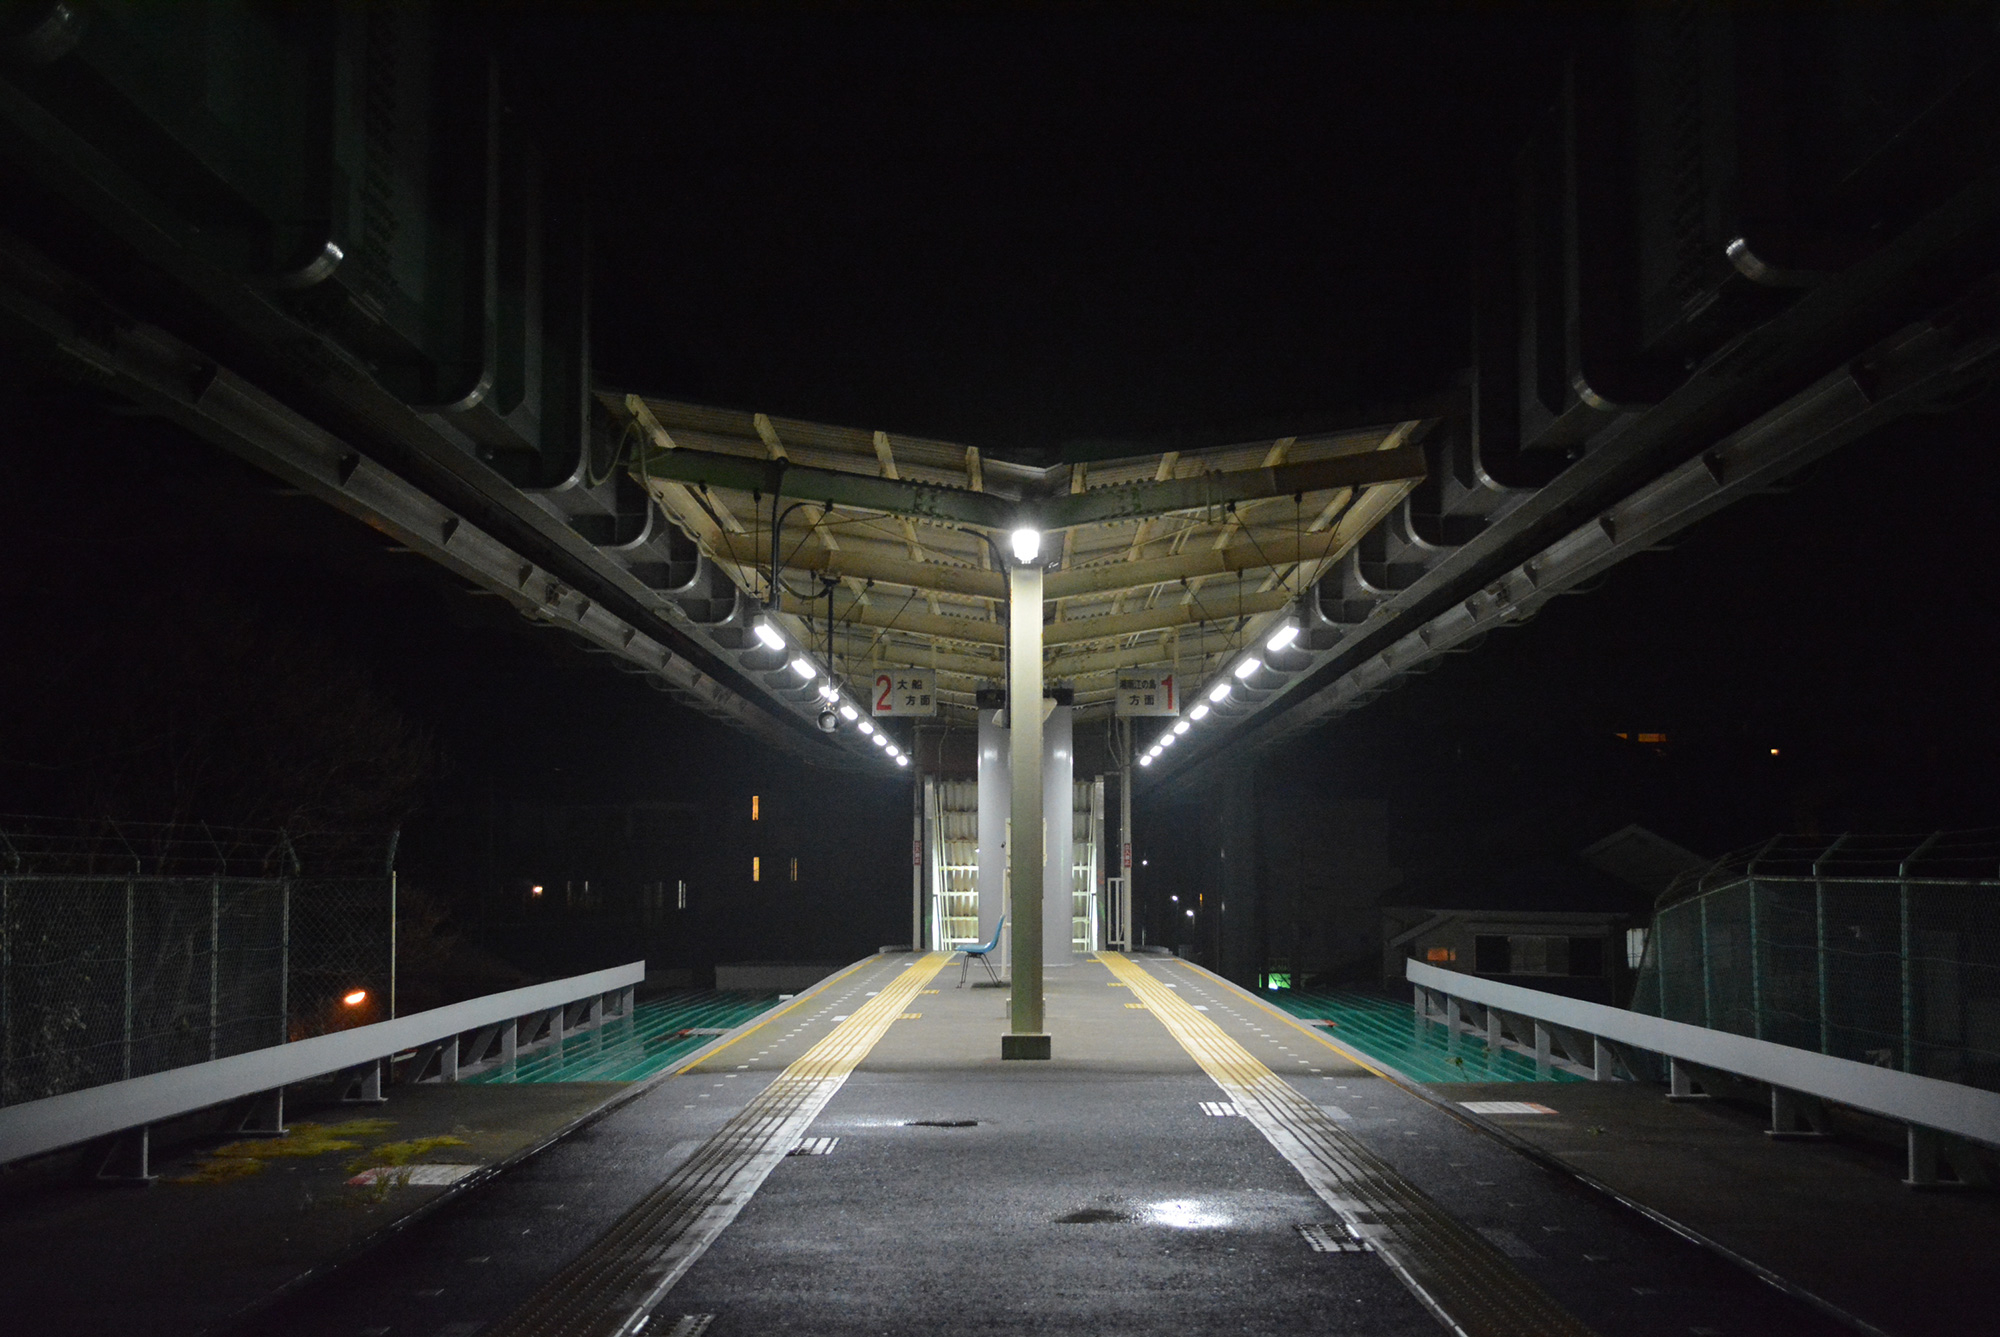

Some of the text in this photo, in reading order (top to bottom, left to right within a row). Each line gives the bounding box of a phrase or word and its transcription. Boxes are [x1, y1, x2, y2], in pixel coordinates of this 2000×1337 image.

[897, 679, 922, 690] 大船
[876, 674, 892, 711] 2
[1161, 674, 1173, 710] 1
[905, 694, 931, 706] 方面
[1129, 694, 1155, 706] 方面
